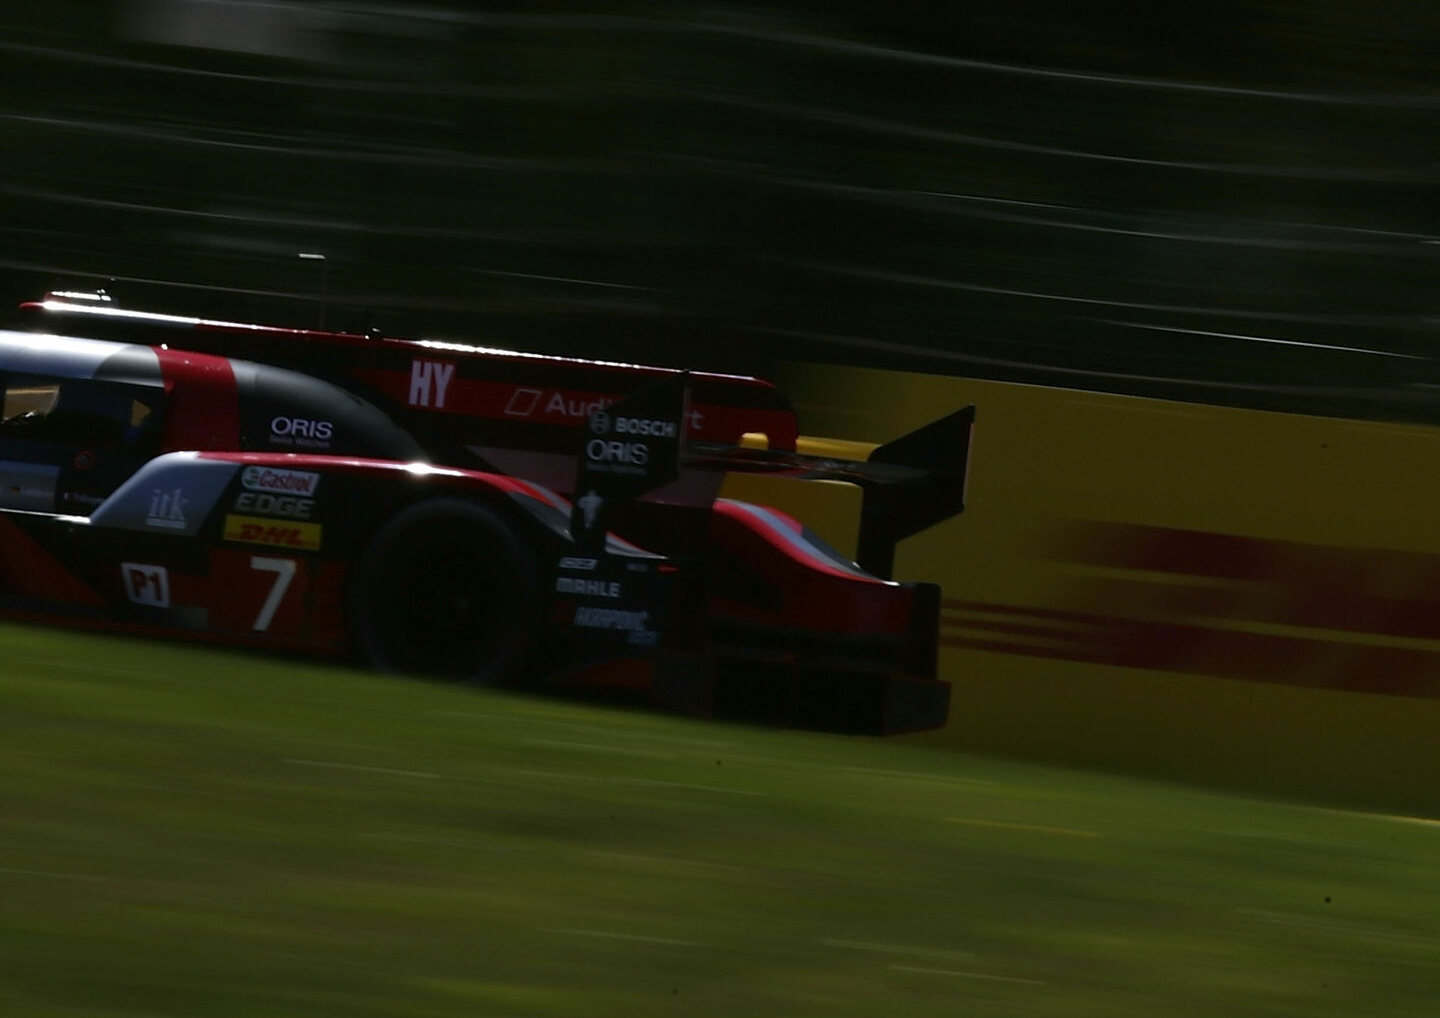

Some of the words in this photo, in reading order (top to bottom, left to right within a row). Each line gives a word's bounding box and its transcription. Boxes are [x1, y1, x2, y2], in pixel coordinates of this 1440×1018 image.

[408, 359, 456, 409] HY
[268, 415, 334, 440] ORIS
[614, 415, 678, 438] BOSCH
[586, 438, 649, 465] ORIS
[259, 469, 314, 493] Castrol
[148, 488, 189, 520] itk
[234, 492, 316, 519] EDGE
[241, 523, 305, 546] DHL
[130, 570, 163, 602] P1
[250, 556, 297, 632] 7
